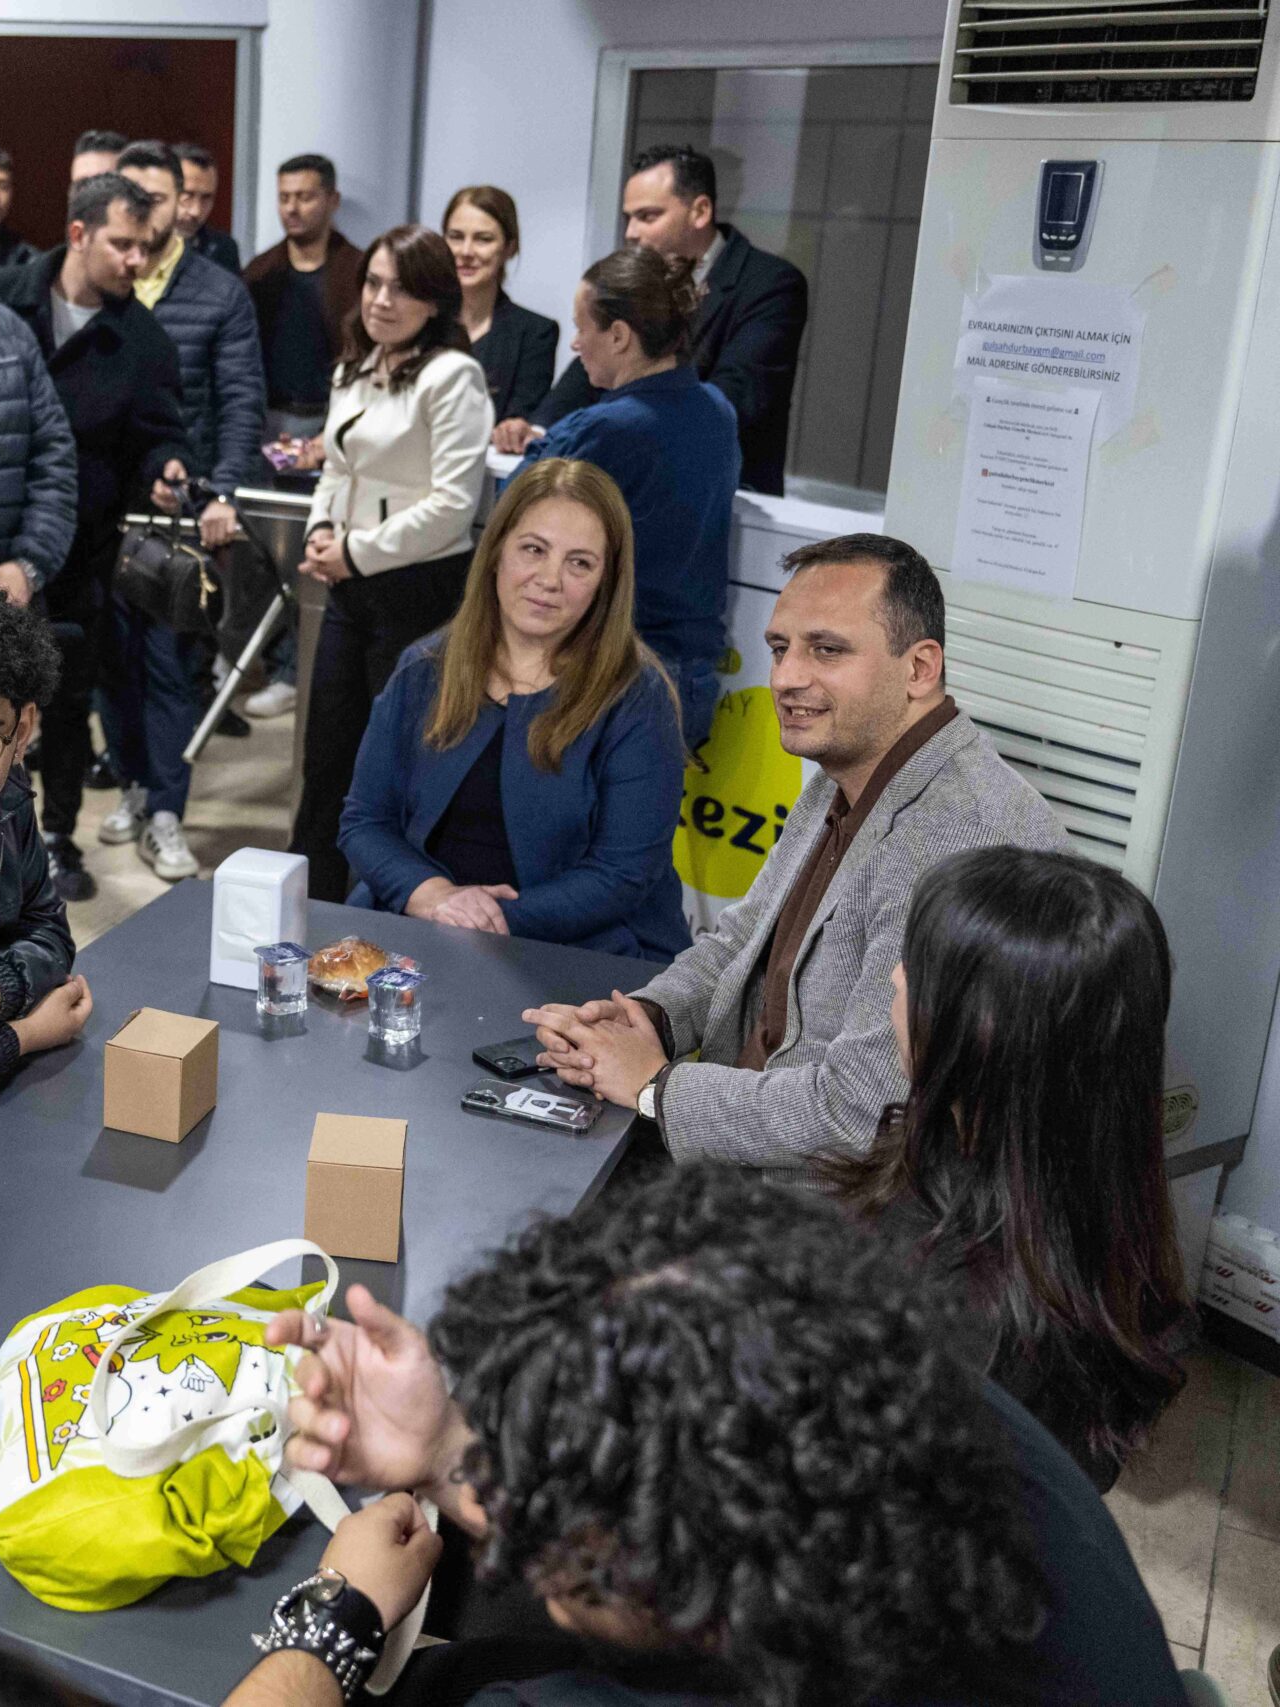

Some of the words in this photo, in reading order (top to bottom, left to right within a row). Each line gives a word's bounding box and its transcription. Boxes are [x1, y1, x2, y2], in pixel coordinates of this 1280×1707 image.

[968, 320, 1034, 335] EVRAKLARINIZIN
[1035, 326, 1074, 339] ÇIKTISINI
[1076, 330, 1109, 342] ALMAK
[1111, 332, 1131, 346] İÇİN
[967, 356, 987, 367] MAİL
[988, 360, 1029, 372] ADRESİNE
[1031, 362, 1121, 382] GÖNDEREBİLİRSİNİZ
[719, 689, 753, 717] AY
[680, 790, 788, 855] ezi
